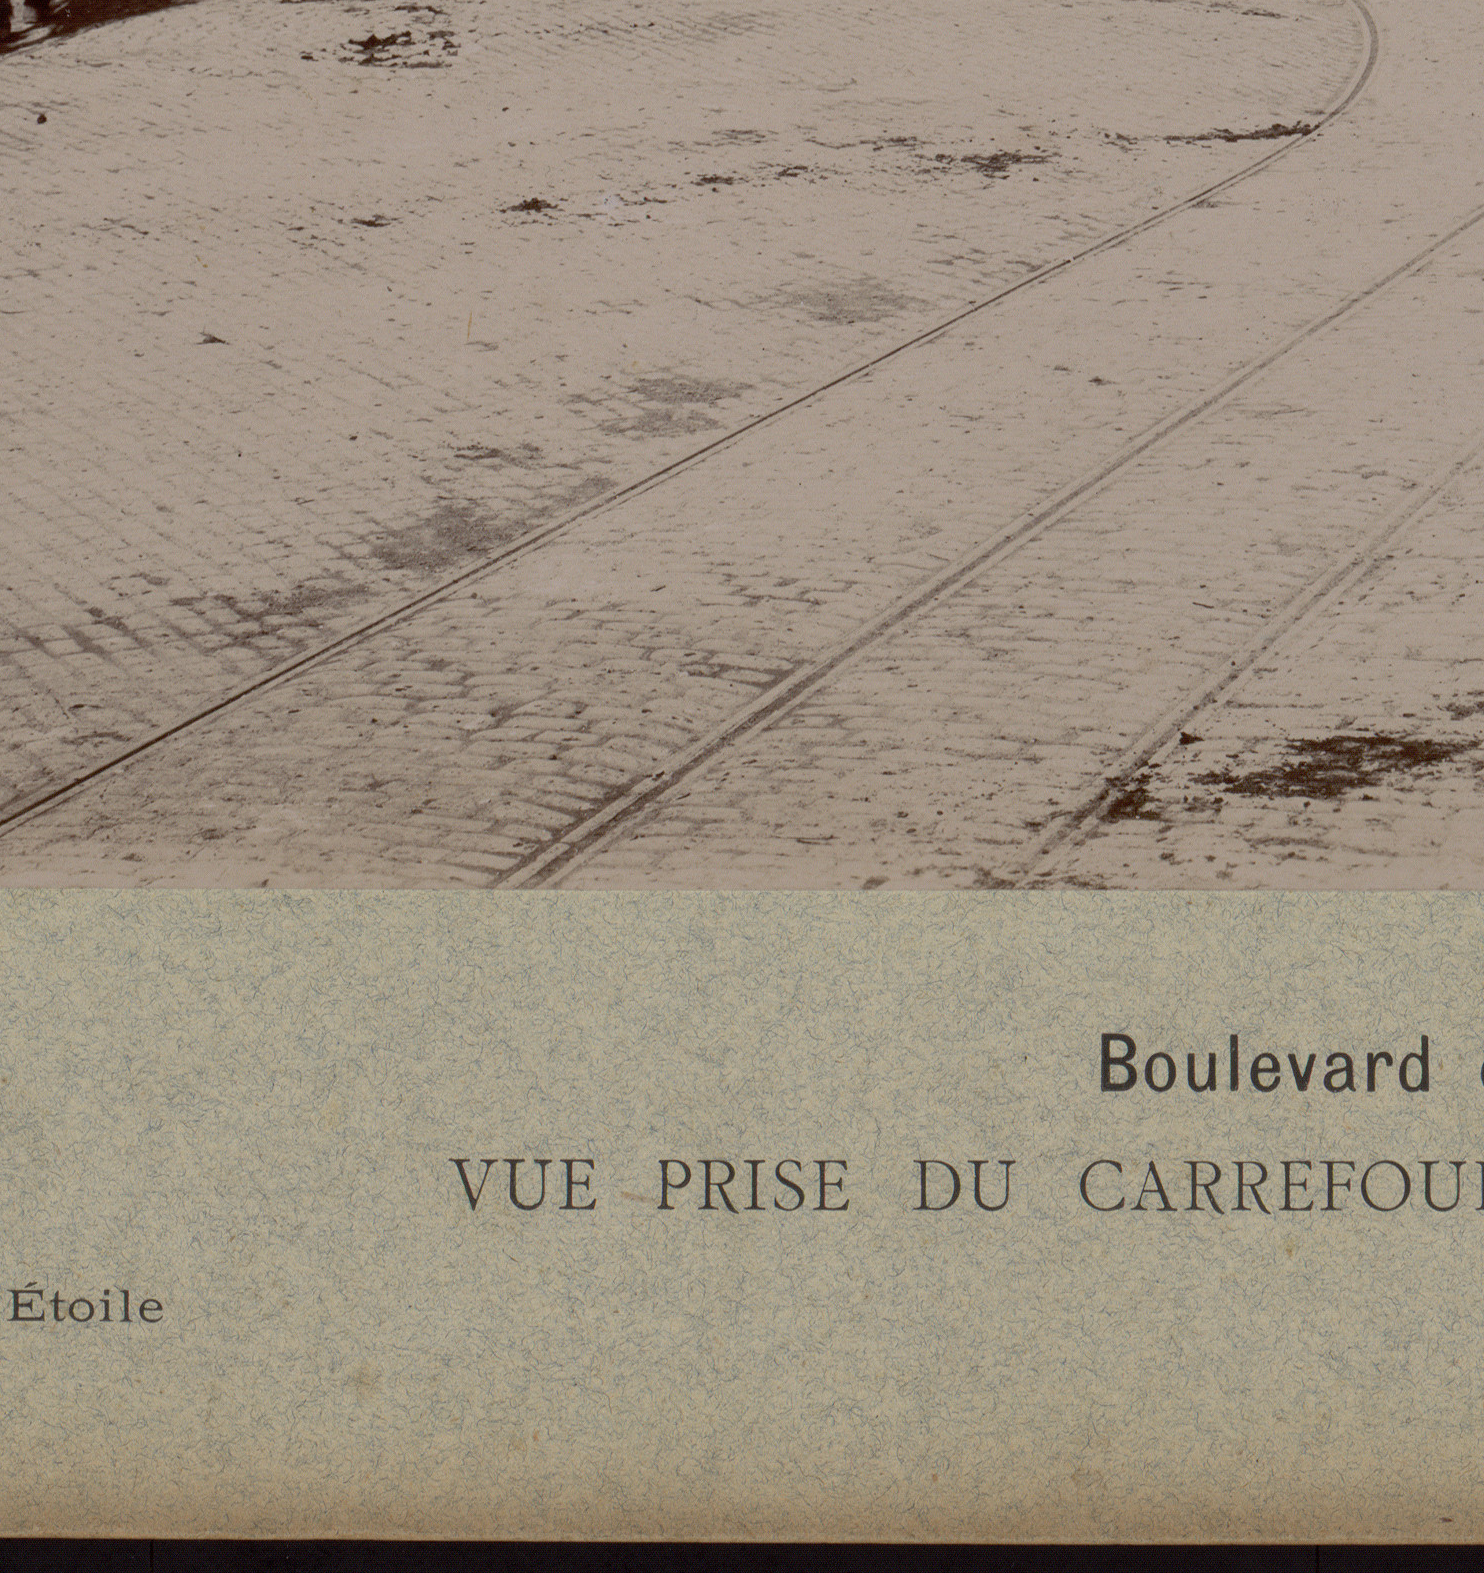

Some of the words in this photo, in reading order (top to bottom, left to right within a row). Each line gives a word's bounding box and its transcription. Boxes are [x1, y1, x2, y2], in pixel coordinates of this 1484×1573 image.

[1099, 1031, 1431, 1093] Boulevard
[451, 1157, 597, 1212] VUE
[657, 1158, 850, 1215] PRISE
[916, 1159, 1016, 1213] DU
